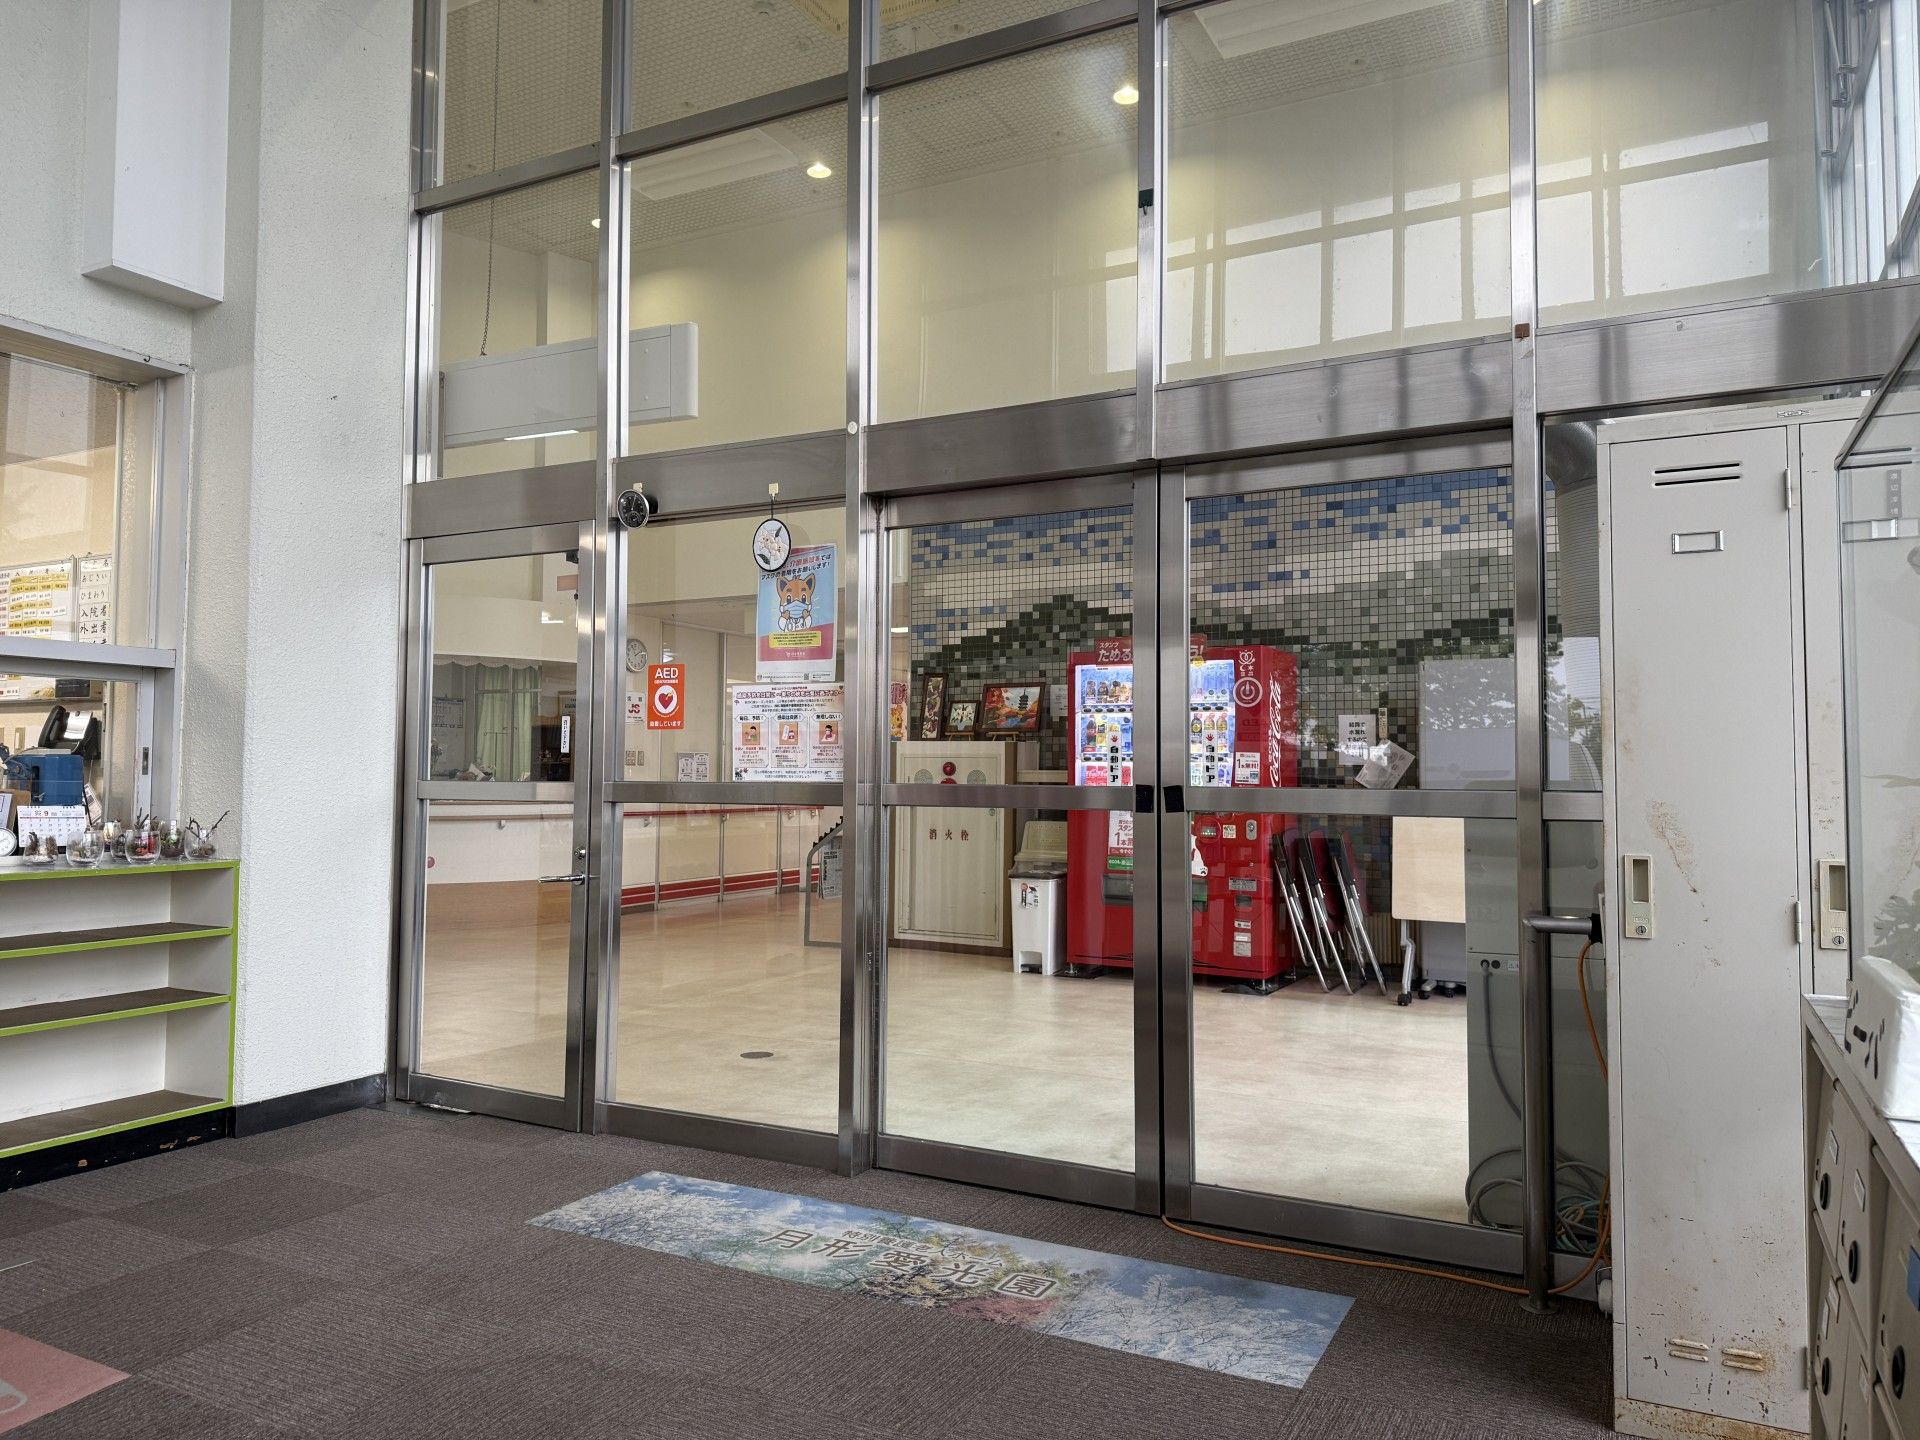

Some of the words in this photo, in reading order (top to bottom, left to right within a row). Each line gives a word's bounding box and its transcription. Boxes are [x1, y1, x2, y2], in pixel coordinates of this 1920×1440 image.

[654, 667, 679, 679] AED
[1109, 745, 1119, 783] 自動ドア
[1205, 744, 1215, 783] 自動ドア
[928, 828, 969, 841] 消火栓
[757, 1228, 1058, 1299] 月形愛光園
